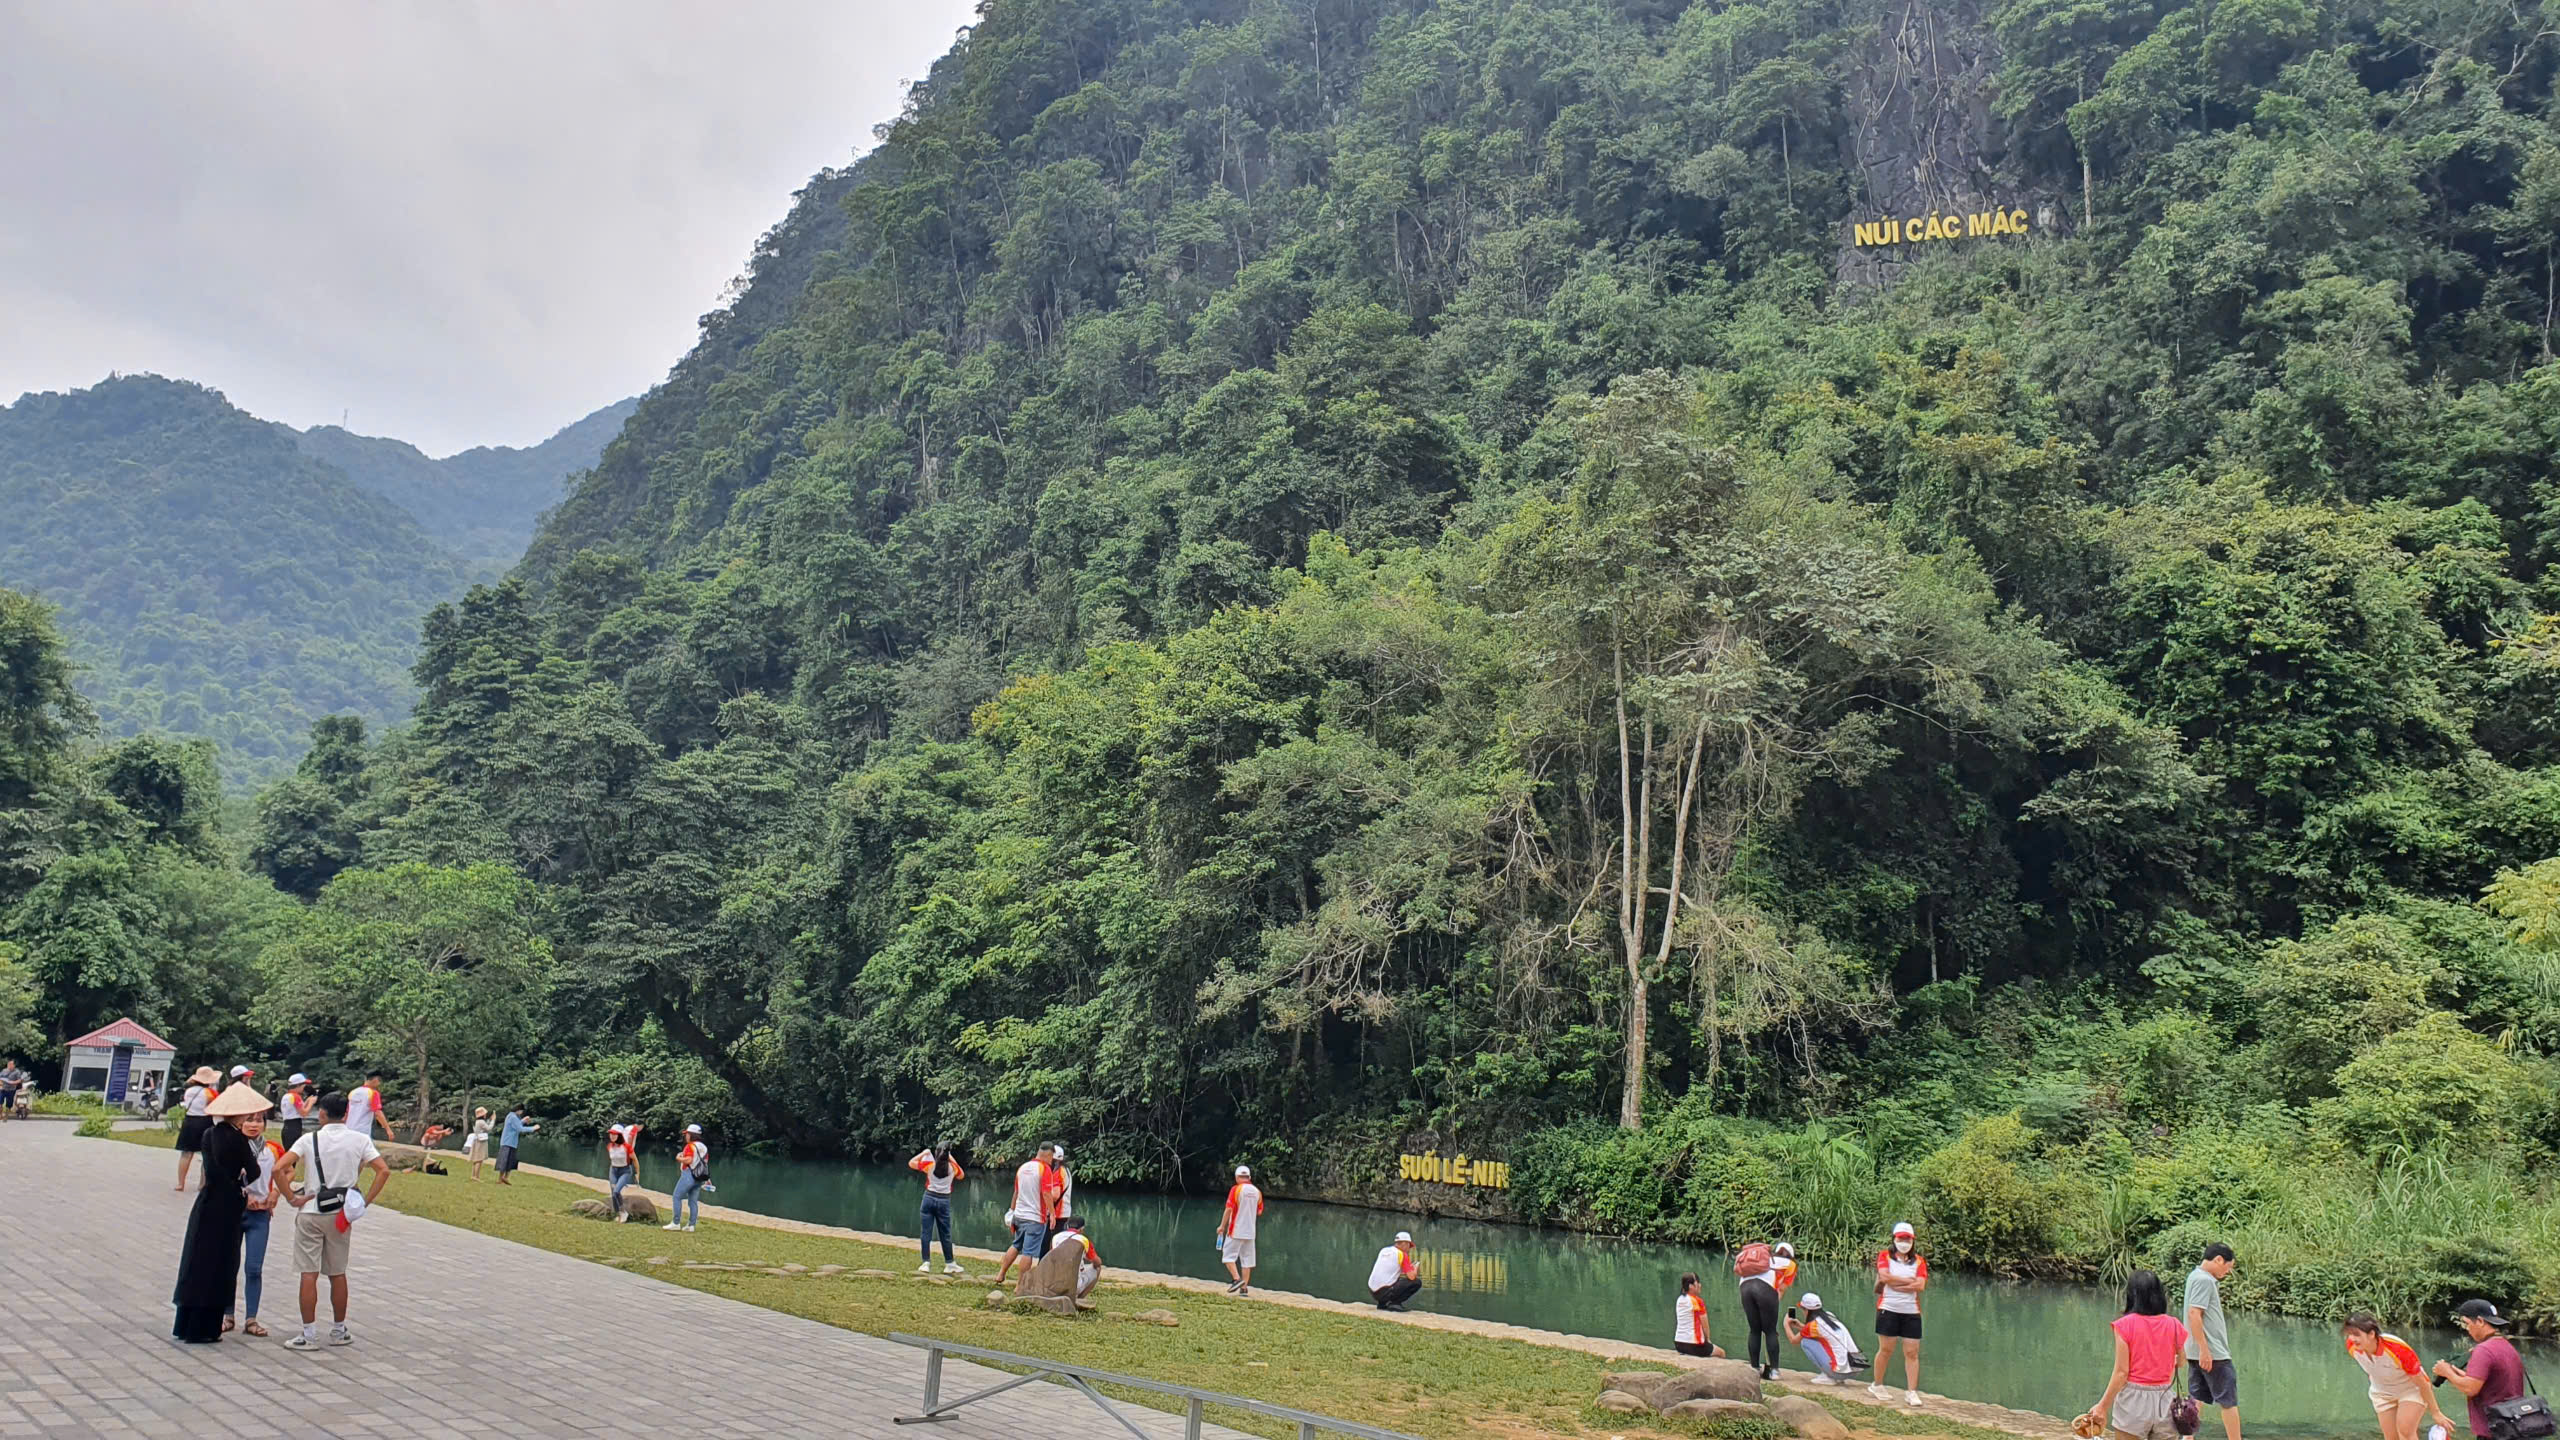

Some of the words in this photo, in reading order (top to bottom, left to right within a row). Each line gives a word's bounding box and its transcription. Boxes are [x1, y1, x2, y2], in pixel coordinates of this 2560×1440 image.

[1854, 215, 1900, 247] NÚI
[1905, 210, 1962, 242] CÁC
[1968, 205, 2029, 237] MÁC
[1399, 1149, 1440, 1183] SUỐI
